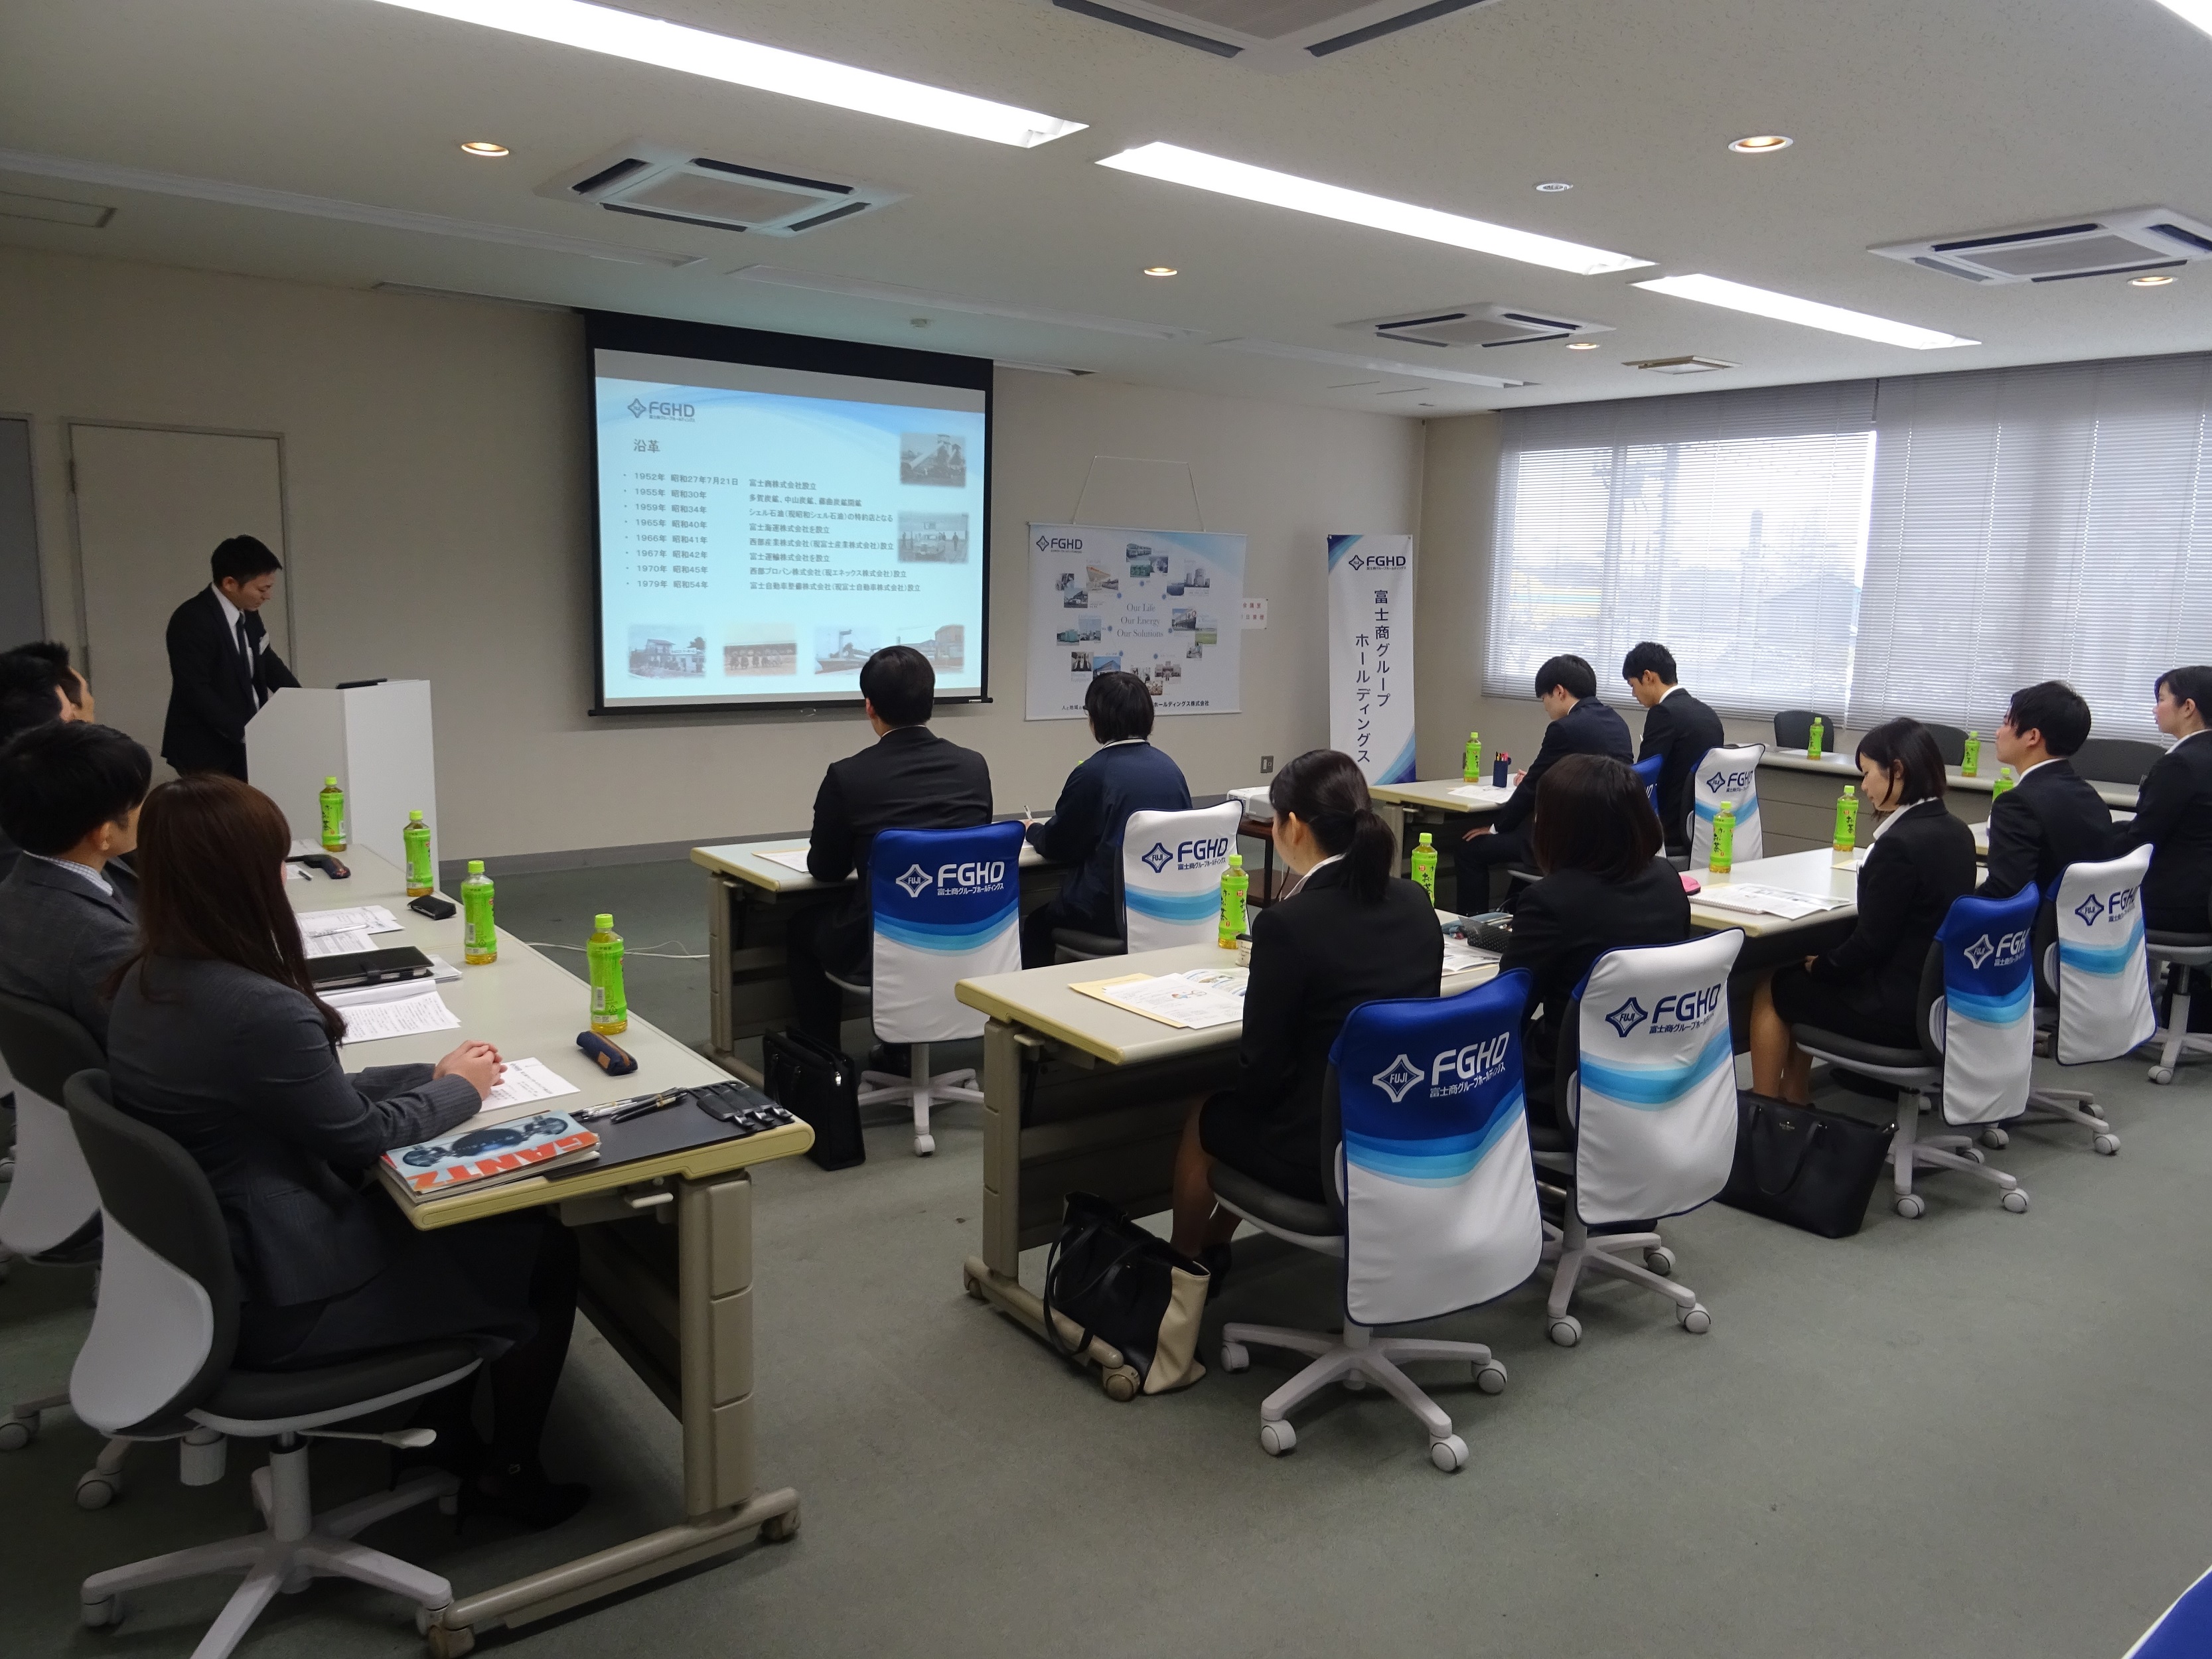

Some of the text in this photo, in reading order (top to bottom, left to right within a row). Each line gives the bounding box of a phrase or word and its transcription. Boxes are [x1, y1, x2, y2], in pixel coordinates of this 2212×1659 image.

[649, 401, 696, 417] FGHD
[633, 439, 660, 454] 沿革
[634, 472, 817, 490] 1952年 昭和27年7月21日 富士商株式会社設立
[671, 490, 707, 498] 昭和30年
[671, 504, 707, 513] 昭和34年
[672, 520, 707, 528] 昭和40年
[636, 534, 667, 543] 1966年
[672, 535, 708, 543] 昭和41年
[1051, 538, 1083, 550] FGHD
[672, 550, 708, 559] 昭和42年
[1366, 556, 1406, 566] FGHD
[673, 580, 709, 589] 昭和54年
[1120, 616, 1160, 627] Our Energy
[1117, 628, 1132, 637] Our
[1133, 629, 1164, 638] Solutions
[1374, 589, 1390, 707] 富士商グループ
[1355, 633, 1370, 763] ホールディングス
[1178, 837, 1228, 862] FGHD
[937, 861, 1005, 887] FGHD
[937, 883, 1004, 896] 富士商グループホールディングス
[1652, 983, 1721, 1024] FGHD
[1619, 1011, 1635, 1022] FUJI
[1432, 1032, 1510, 1086] FGHD
[1390, 1072, 1408, 1084] FUJI
